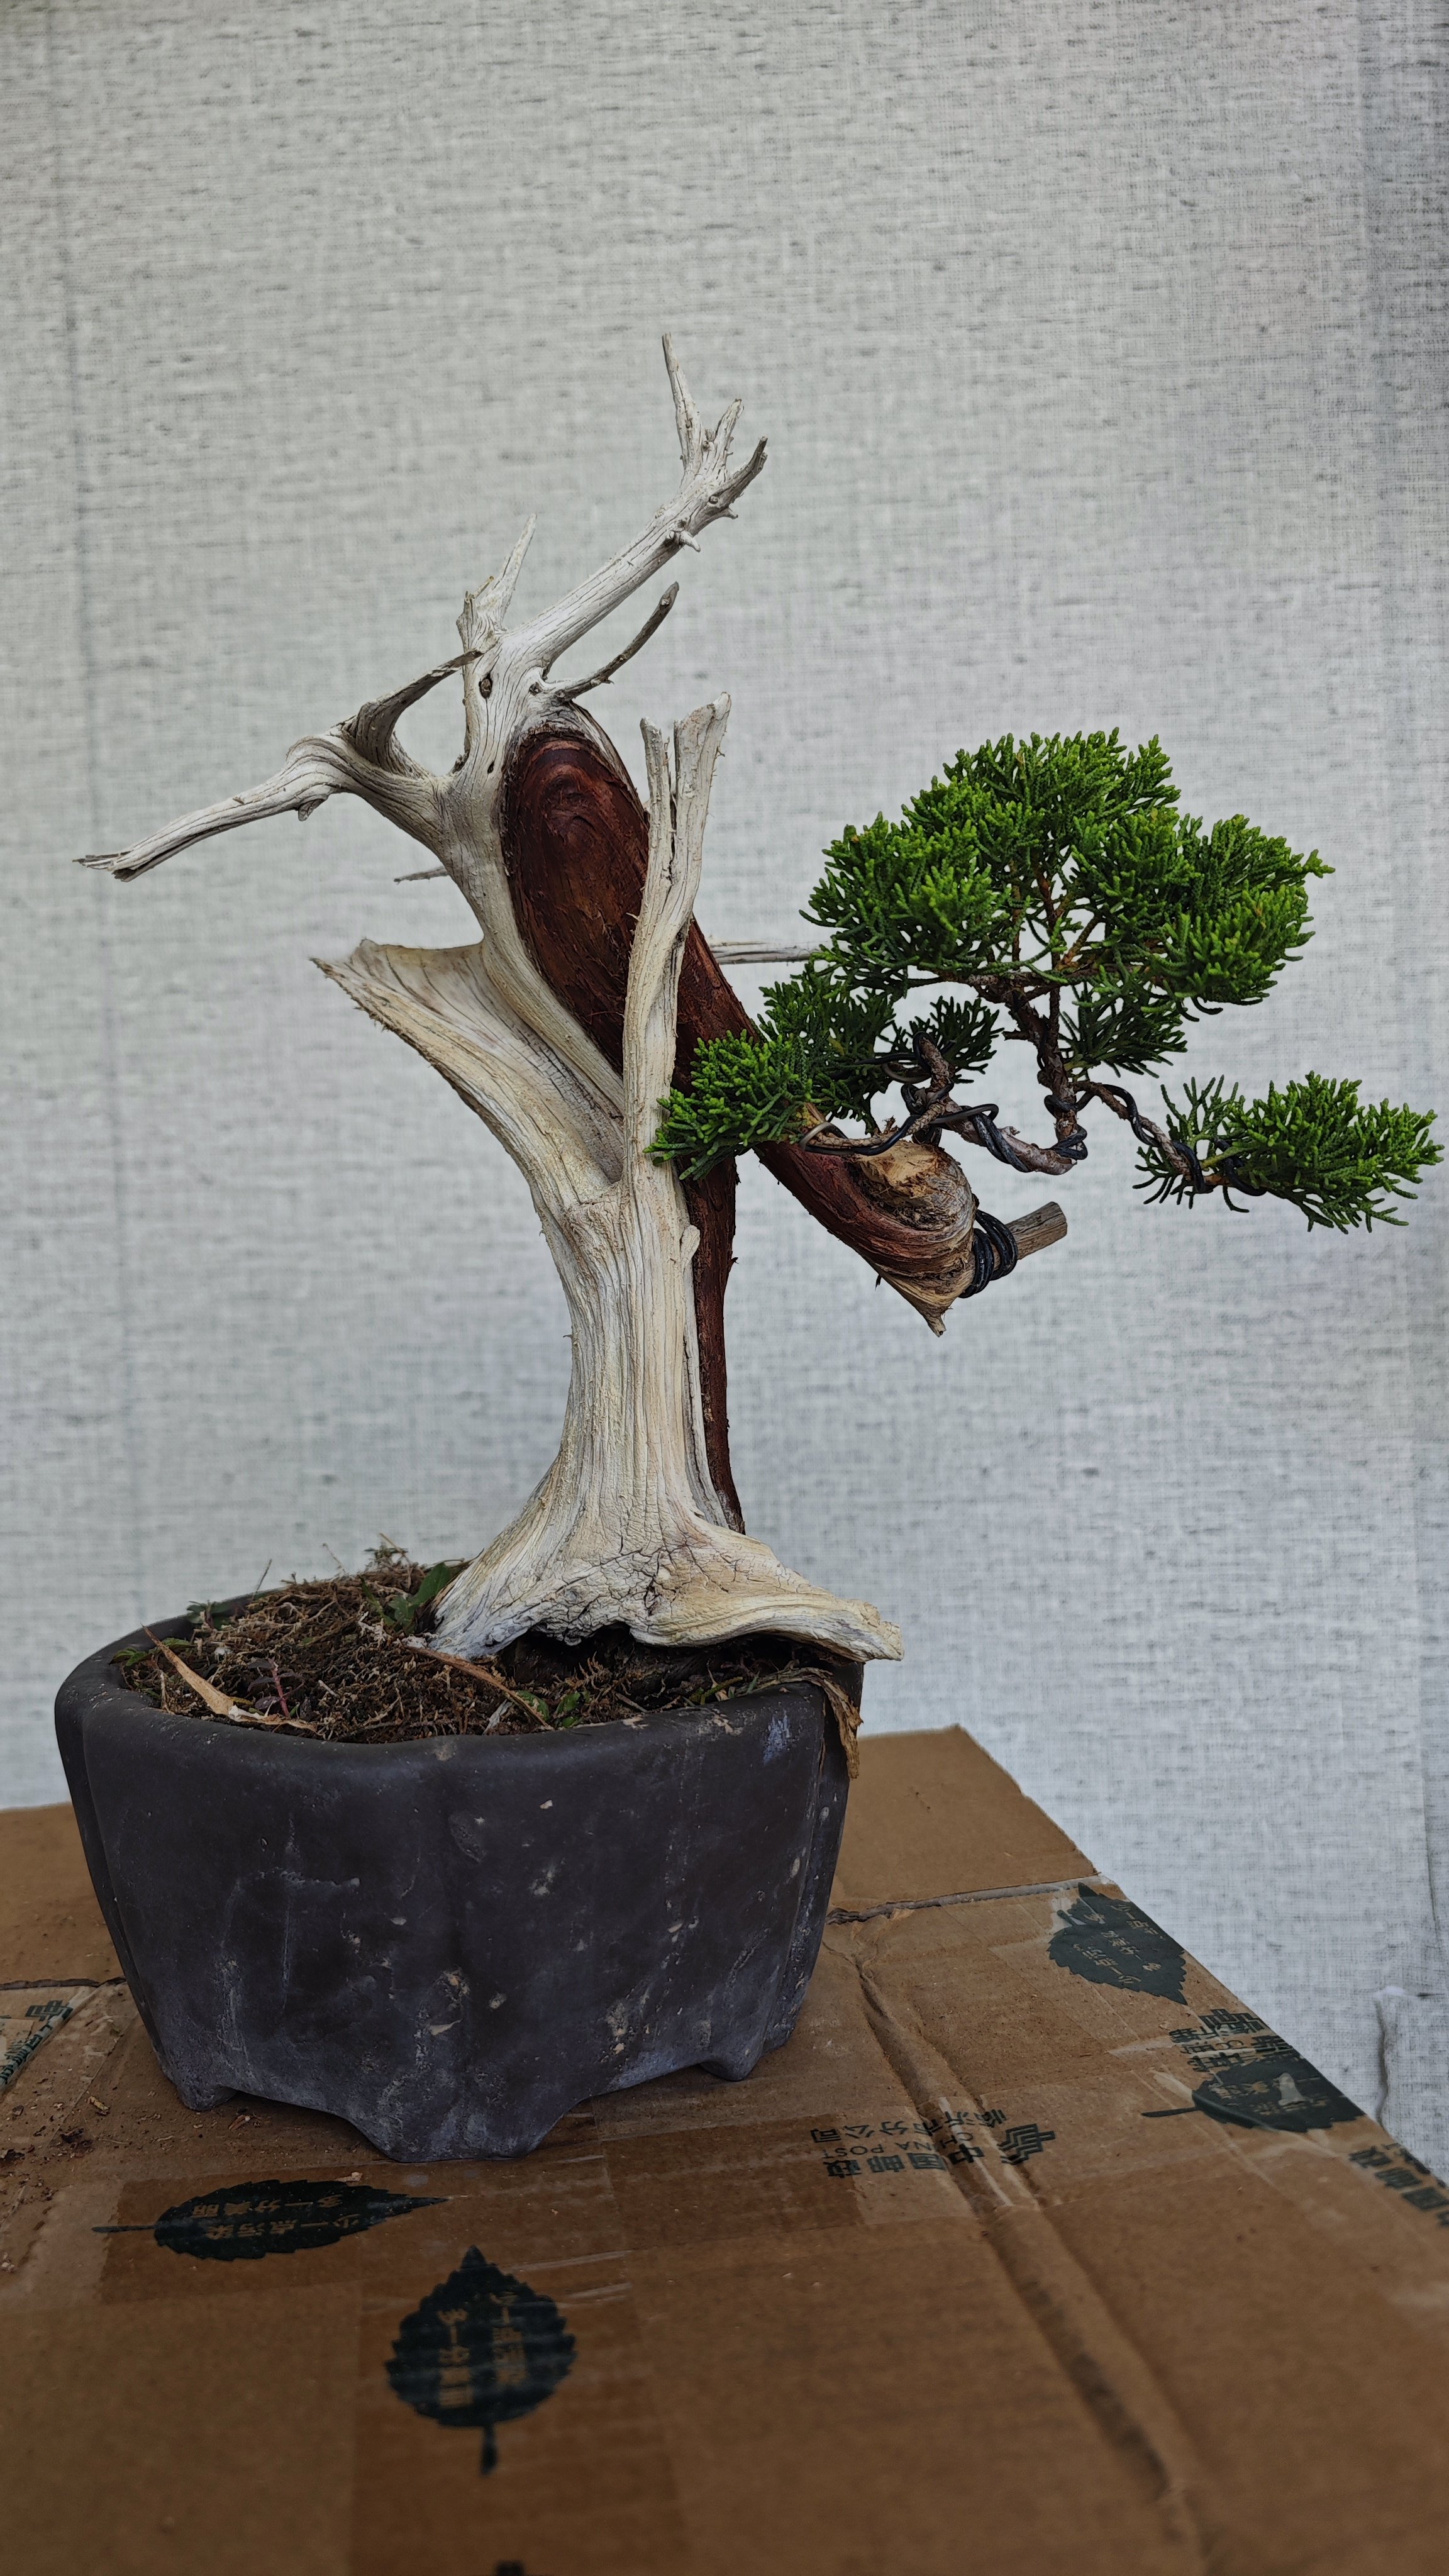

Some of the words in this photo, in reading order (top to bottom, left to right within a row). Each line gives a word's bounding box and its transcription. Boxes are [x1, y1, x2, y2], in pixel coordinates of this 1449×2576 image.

[810, 2109, 1007, 2143] 临沂市分公司
[822, 2144, 884, 2159] POST
[894, 2132, 974, 2151] CHNA
[823, 2143, 985, 2178] 中国邮政
[206, 2214, 360, 2240] 少一点污染
